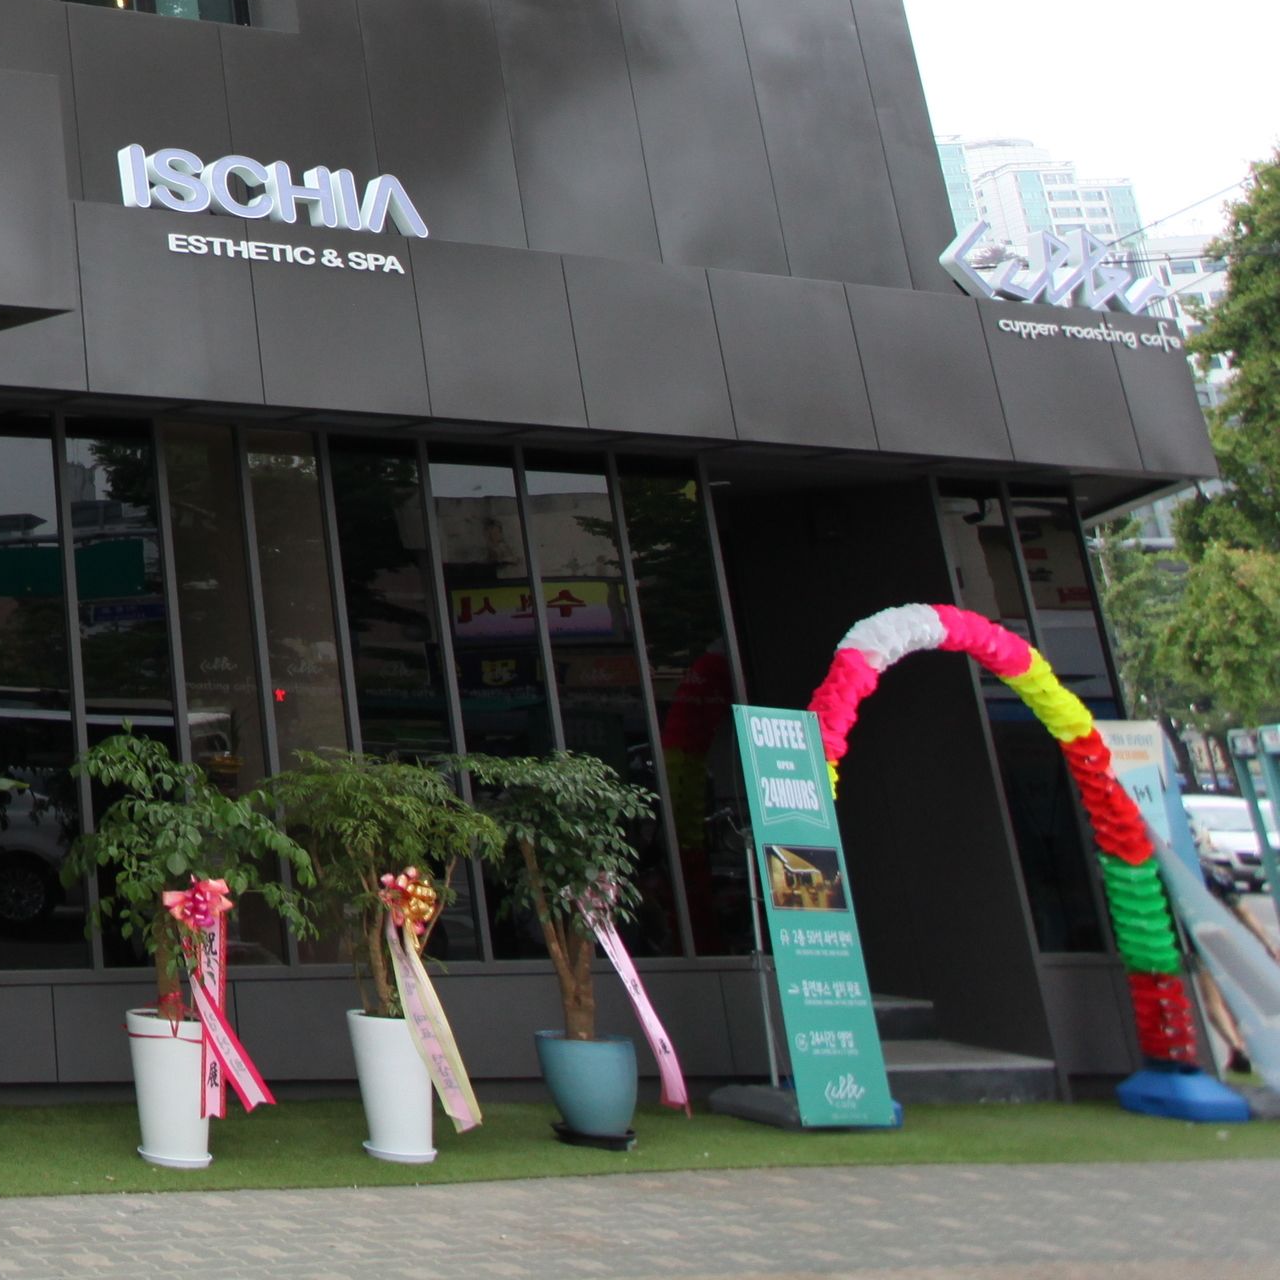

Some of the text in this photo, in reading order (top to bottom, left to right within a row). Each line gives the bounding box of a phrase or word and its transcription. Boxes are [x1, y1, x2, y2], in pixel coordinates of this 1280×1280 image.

[117, 143, 429, 238] ISCHIA
[167, 233, 405, 275] ESTHETIC & SPA
[998, 318, 1182, 352] cupper roasting cafe
[750, 716, 807, 750] COFFEE
[776, 759, 795, 771] OPEN
[761, 776, 819, 811] 24HOURS
